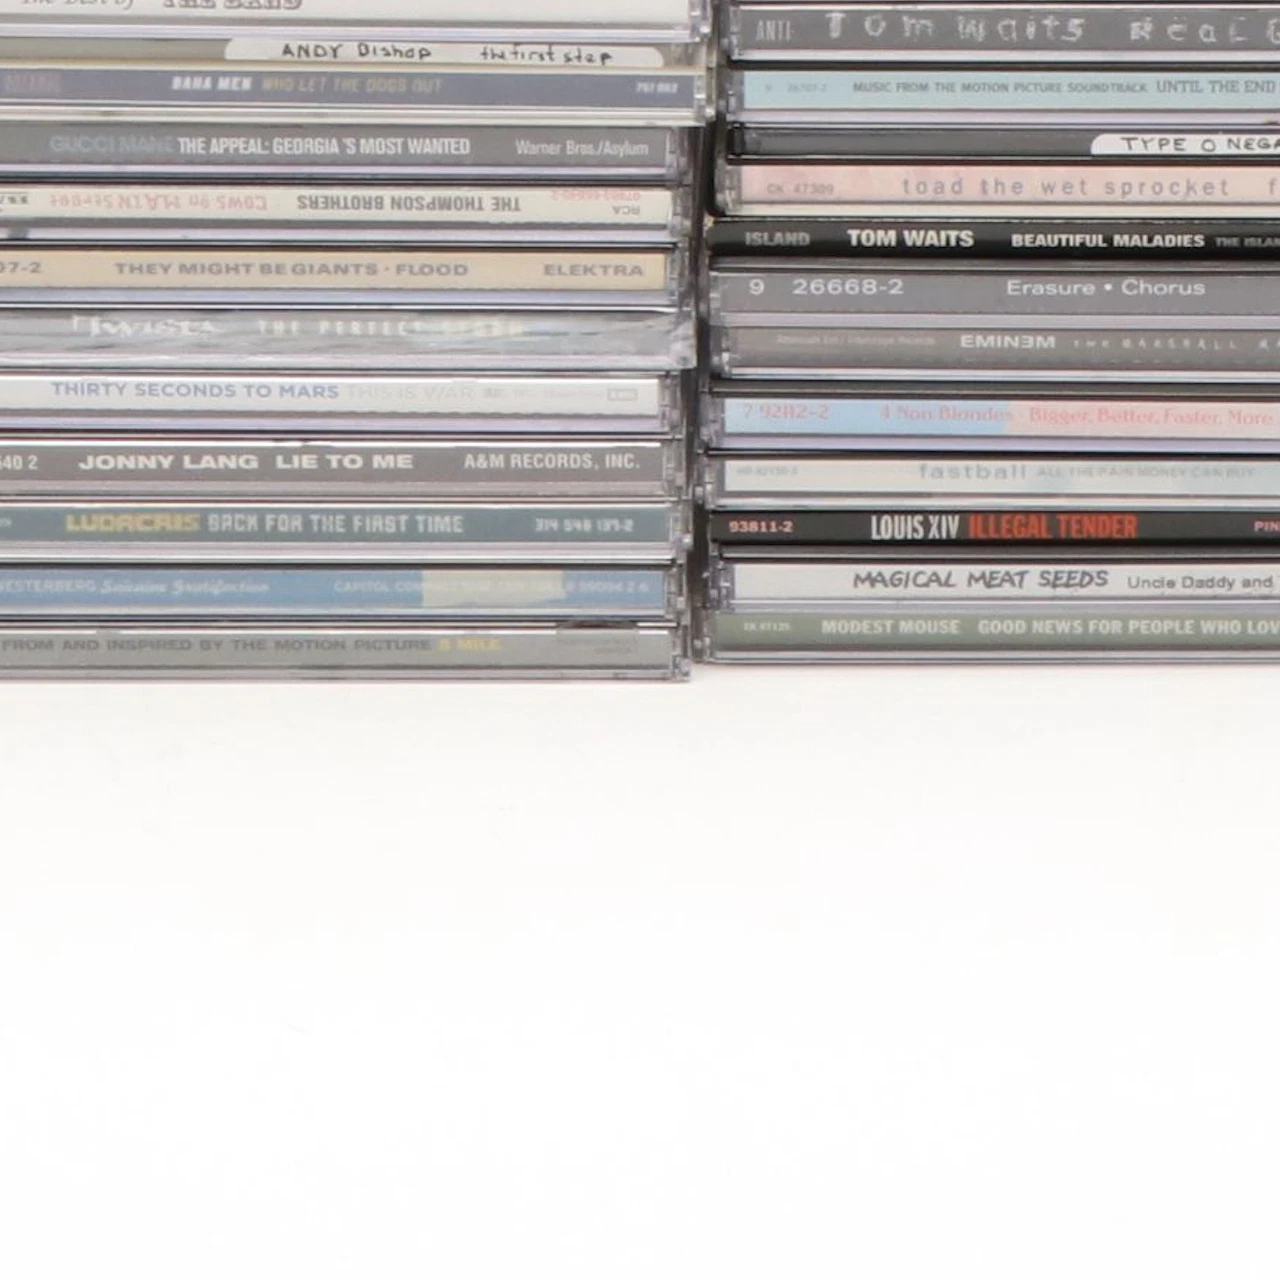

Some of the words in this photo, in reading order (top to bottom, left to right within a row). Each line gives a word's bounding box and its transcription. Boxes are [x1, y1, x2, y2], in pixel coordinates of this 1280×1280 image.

[1121, 137, 1185, 151] TYPE
[1202, 136, 1215, 152] O
[848, 230, 896, 247] TOM
[901, 230, 974, 247] WAITS
[1012, 234, 1106, 247] BEAUTIFUL
[1114, 235, 1205, 248] MALADIES
[52, 382, 127, 396] THIRTY
[135, 383, 235, 397] SECONDS
[244, 385, 272, 398] TO
[280, 382, 339, 398] MARS
[79, 455, 173, 469] JONNY
[184, 455, 258, 469] LANG
[276, 455, 317, 468] LIE
[326, 455, 363, 468] TO
[373, 455, 412, 468] ME
[871, 514, 920, 540] LOUIS
[927, 515, 961, 540] XIV
[969, 514, 1048, 538] ILLEGAL
[1059, 516, 1138, 538] TENDER
[822, 620, 892, 636] MODEST
[900, 620, 959, 635] MOUSE
